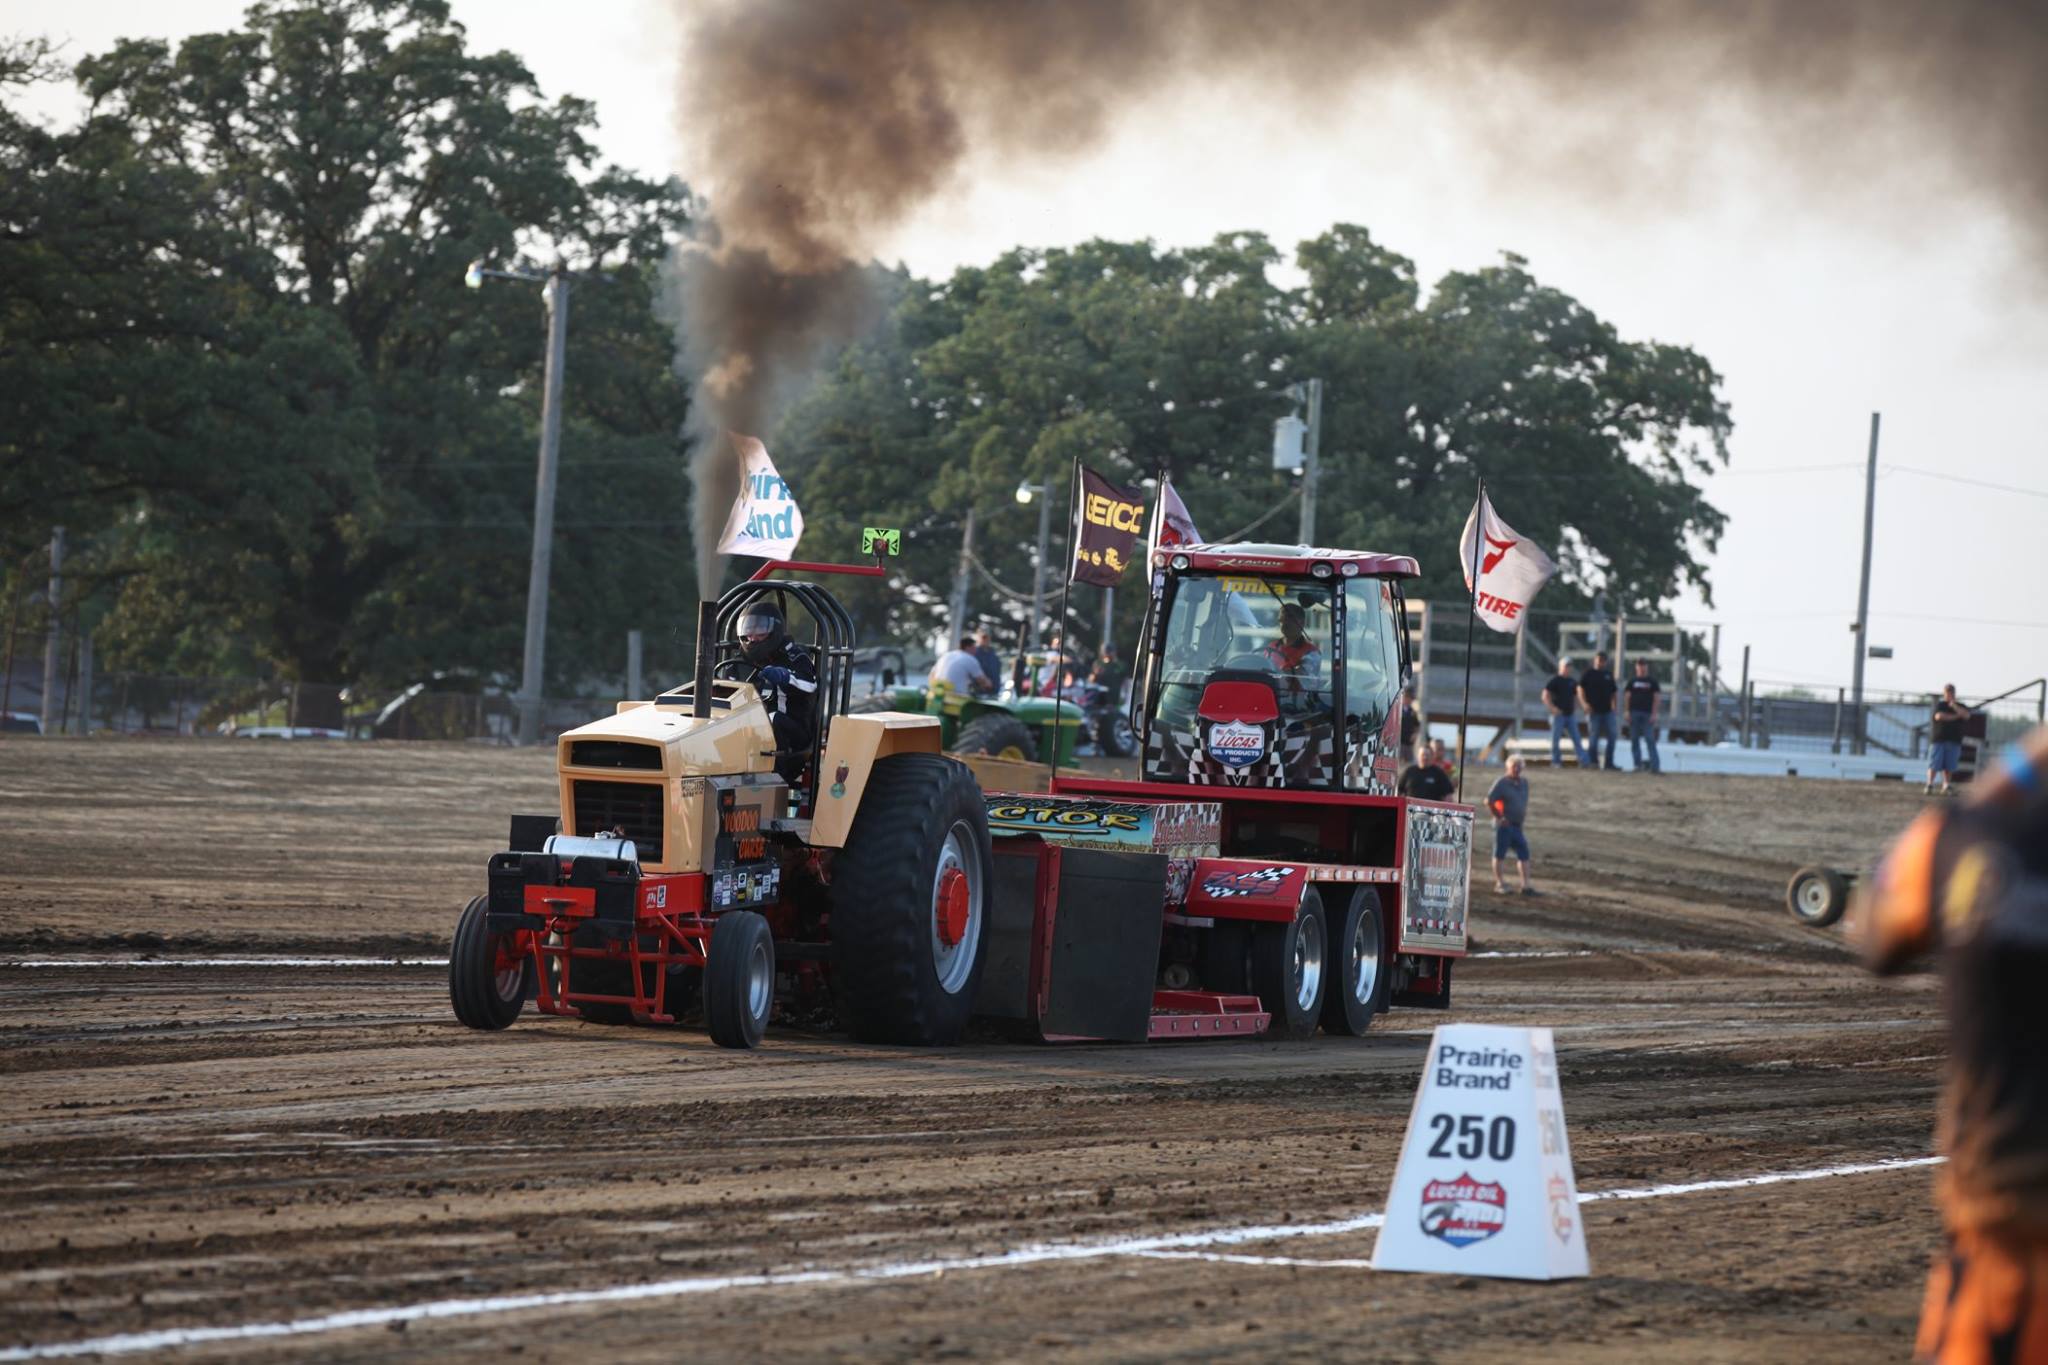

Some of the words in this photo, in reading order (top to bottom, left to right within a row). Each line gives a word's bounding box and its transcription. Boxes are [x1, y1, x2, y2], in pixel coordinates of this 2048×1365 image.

[1478, 591, 1525, 619] TIRE
[1216, 736, 1259, 748] LUCAS
[1438, 1046, 1522, 1068] Prairie
[1435, 1068, 1511, 1090] Brand
[1427, 1113, 1516, 1162] 250
